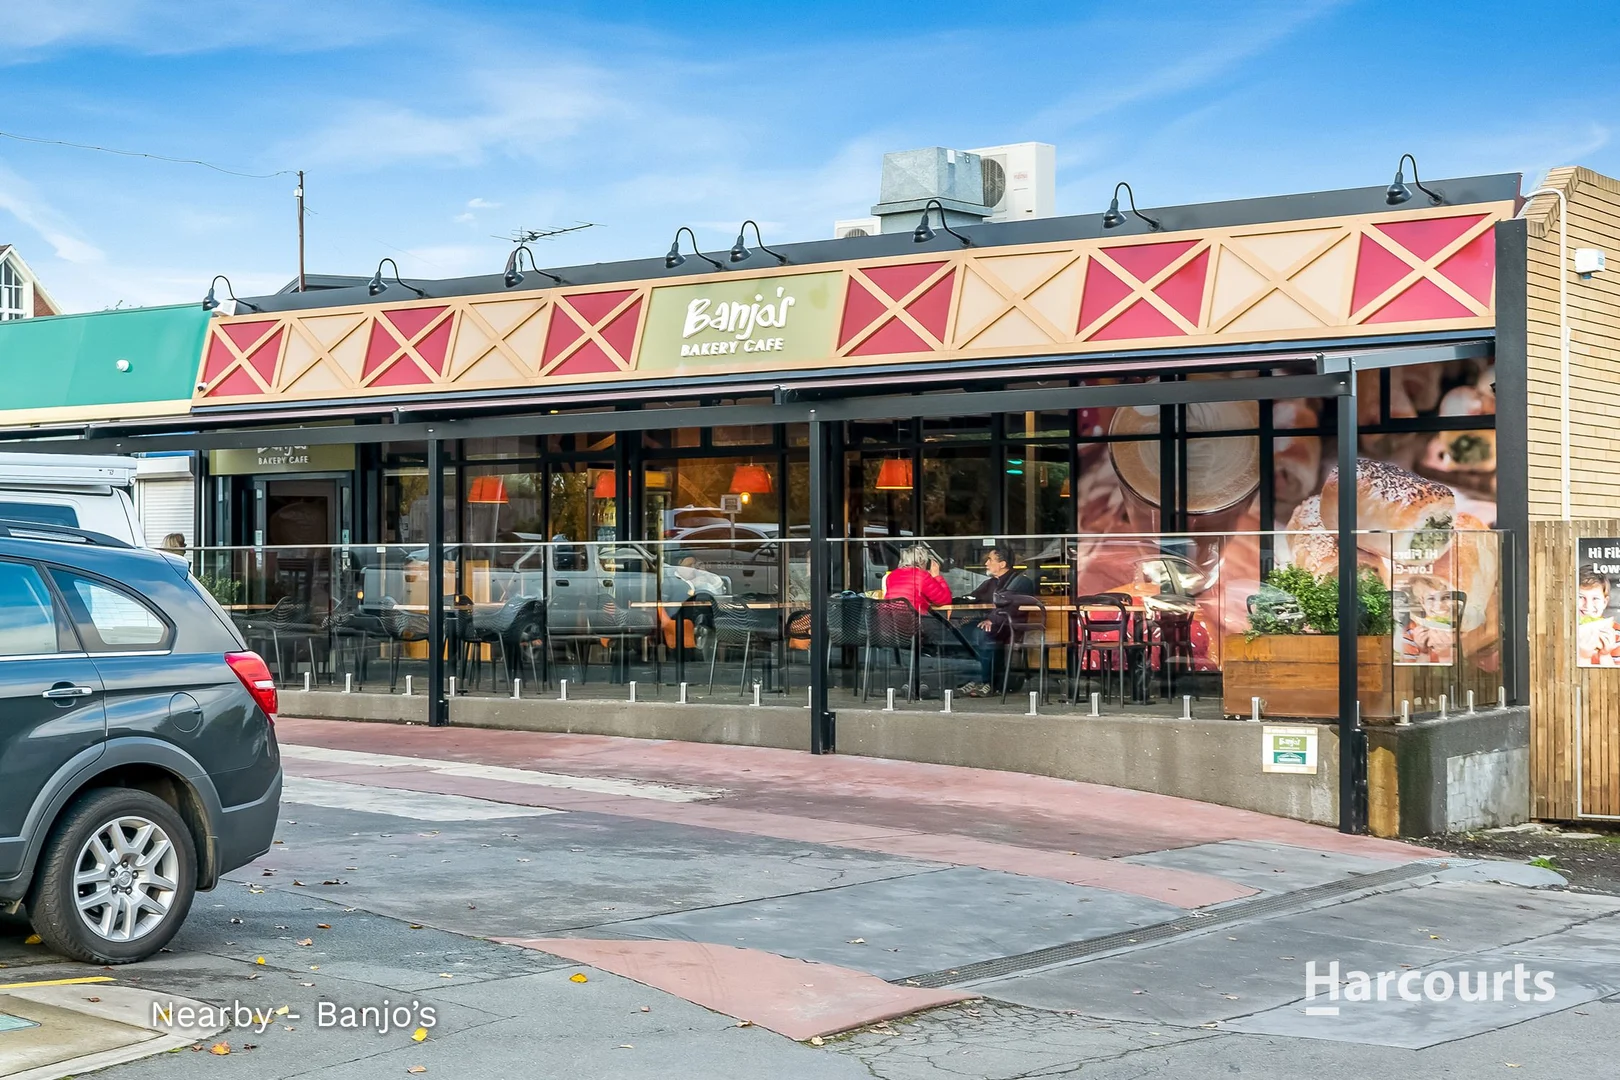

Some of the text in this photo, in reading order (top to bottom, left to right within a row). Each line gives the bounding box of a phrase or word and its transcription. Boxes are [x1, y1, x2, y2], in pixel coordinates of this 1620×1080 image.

[682, 286, 796, 340] Banjo's
[680, 337, 785, 357] BAKERY CAFE
[258, 455, 309, 465] BAKERY CAFE
[1588, 547, 1602, 559] Hi
